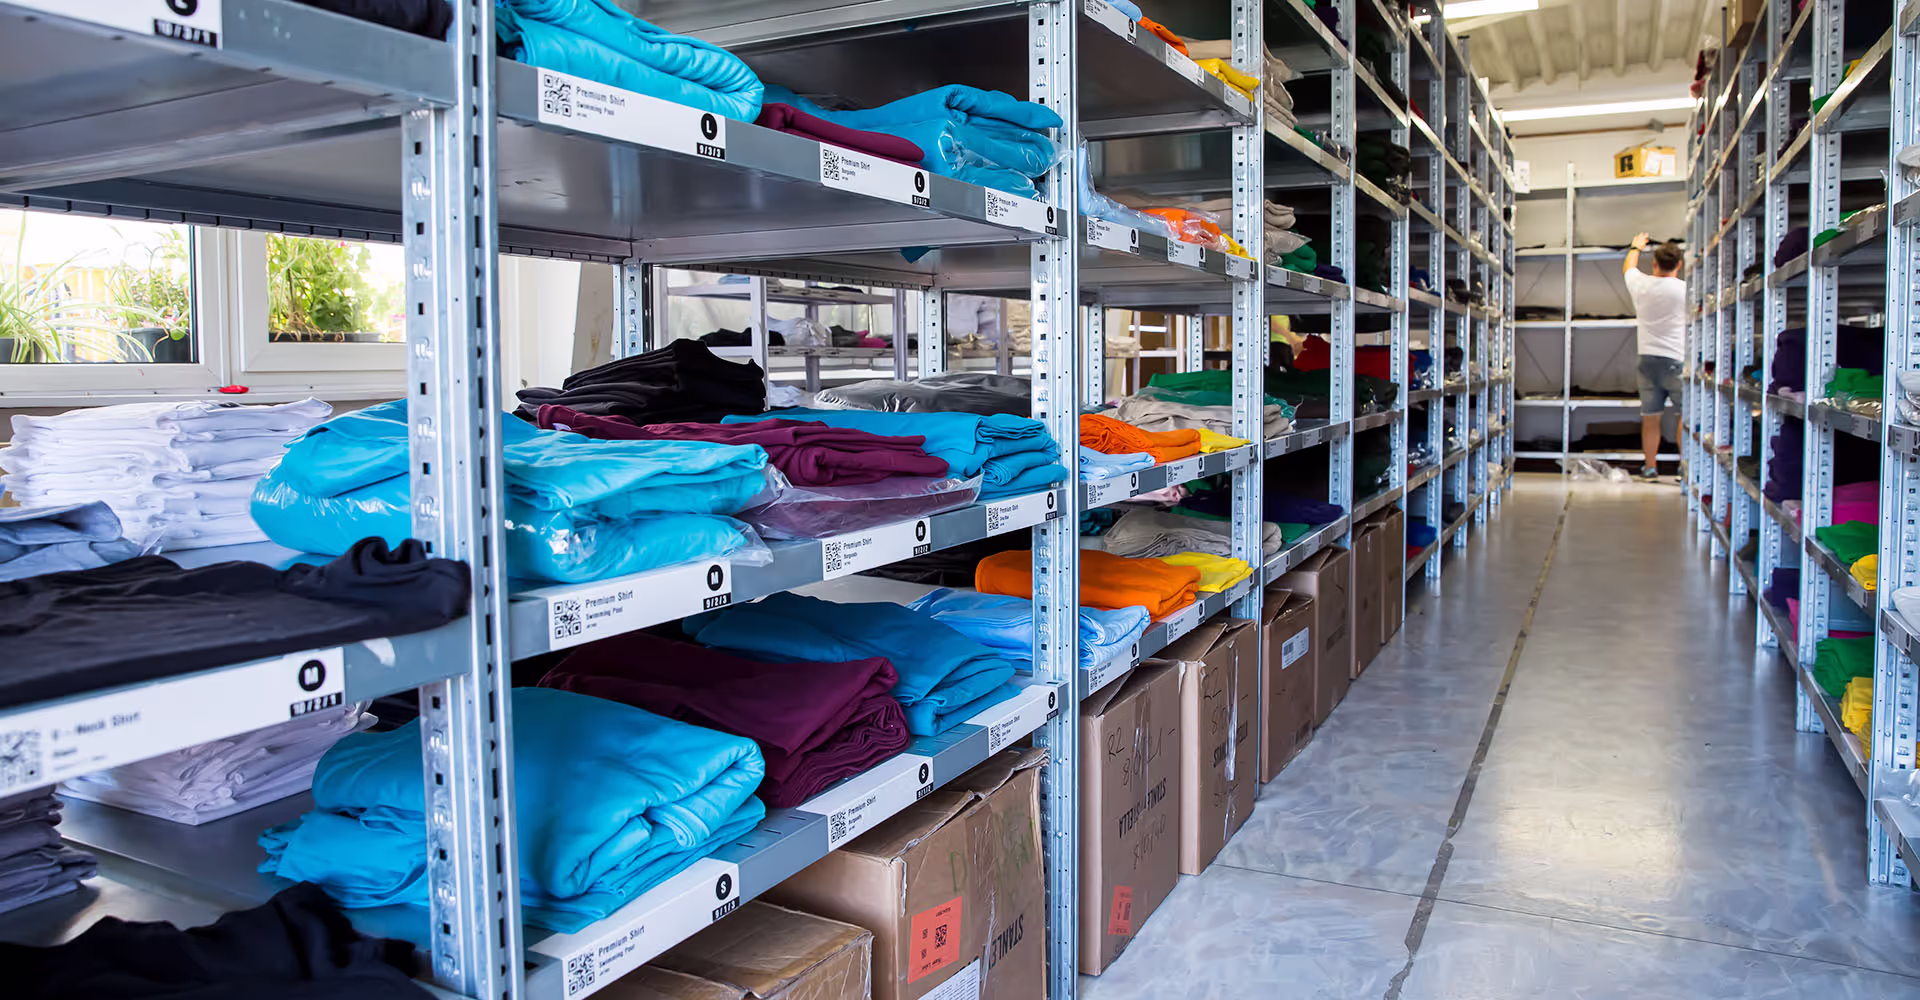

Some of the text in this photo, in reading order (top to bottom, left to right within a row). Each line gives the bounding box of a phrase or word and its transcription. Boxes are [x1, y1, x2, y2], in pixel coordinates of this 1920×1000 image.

[706, 120, 712, 133] L
[699, 144, 721, 158] 9/3/3
[711, 571, 719, 585] M
[585, 590, 633, 608] Premium Shirt
[706, 595, 727, 609] 9/2/3
[304, 667, 319, 685] M
[921, 768, 926, 779] S
[720, 880, 727, 894] S
[714, 899, 736, 919] 9/1/3
[598, 924, 645, 957] Premium Shirt
